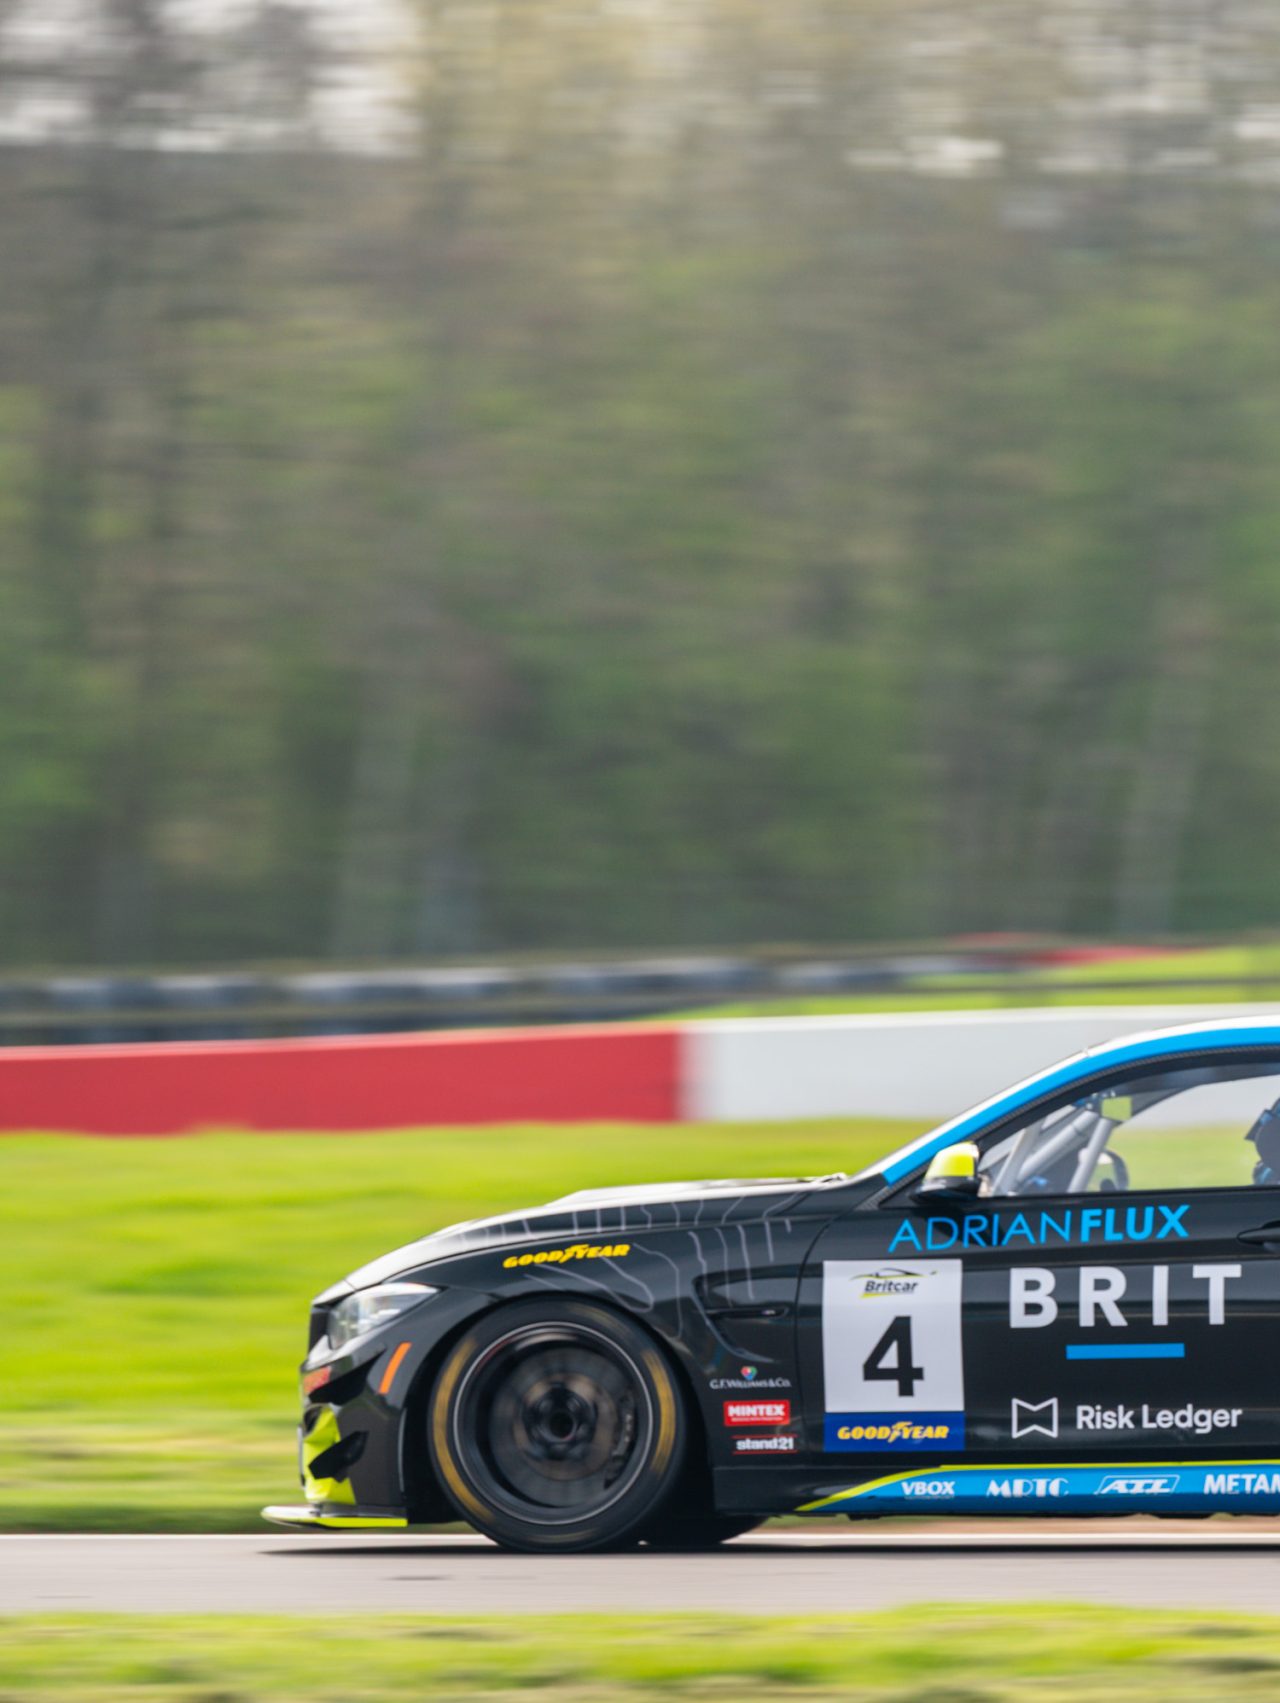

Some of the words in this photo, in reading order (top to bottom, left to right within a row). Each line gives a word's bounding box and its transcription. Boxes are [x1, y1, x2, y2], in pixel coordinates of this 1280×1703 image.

[502, 1244, 631, 1268] GOODYEAR
[863, 1280, 919, 1294] Britcar
[1009, 1264, 1242, 1328] BRIT
[863, 1315, 925, 1398] 4
[727, 1404, 785, 1417] MINTEX
[1076, 1405, 1135, 1429] Risk
[1142, 1404, 1243, 1434] Ledger
[837, 1421, 949, 1443] GOODYEAR
[736, 1437, 794, 1451] stand21
[901, 1481, 955, 1496] VBOX
